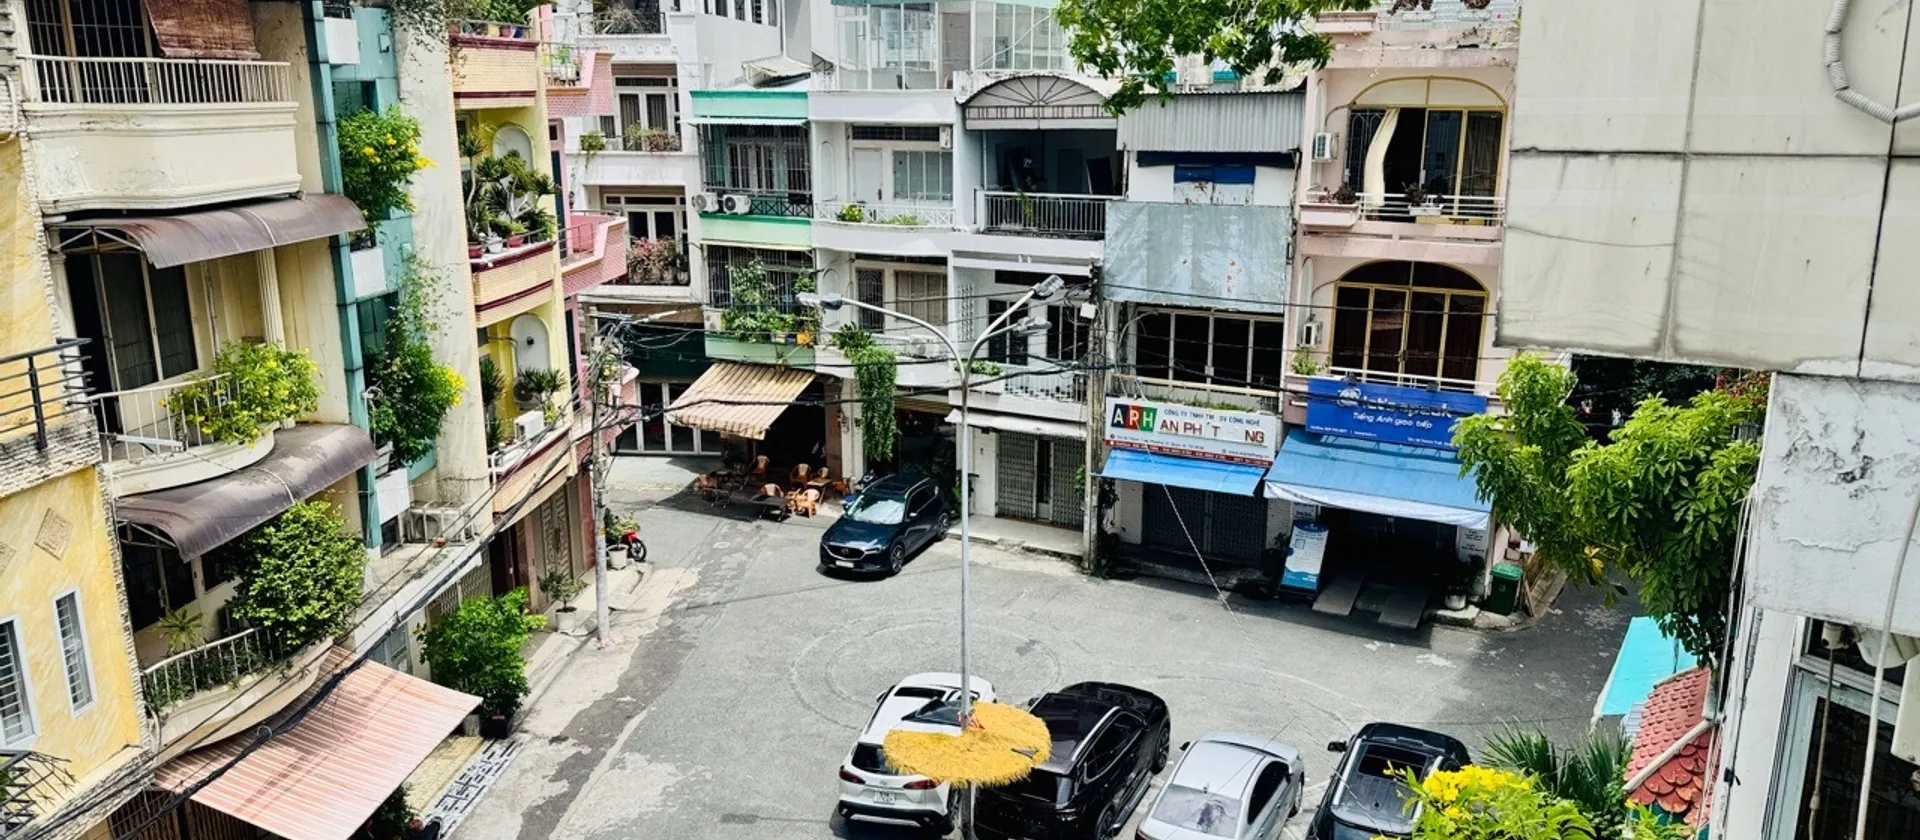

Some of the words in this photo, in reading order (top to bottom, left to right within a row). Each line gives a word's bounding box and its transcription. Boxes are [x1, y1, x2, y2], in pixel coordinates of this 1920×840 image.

[1160, 419, 1179, 433] AN
[1353, 412, 1374, 423] Tiếng
[1376, 415, 1393, 423] Anh
[1394, 418, 1413, 426] giao
[1416, 419, 1433, 429] tiếp
